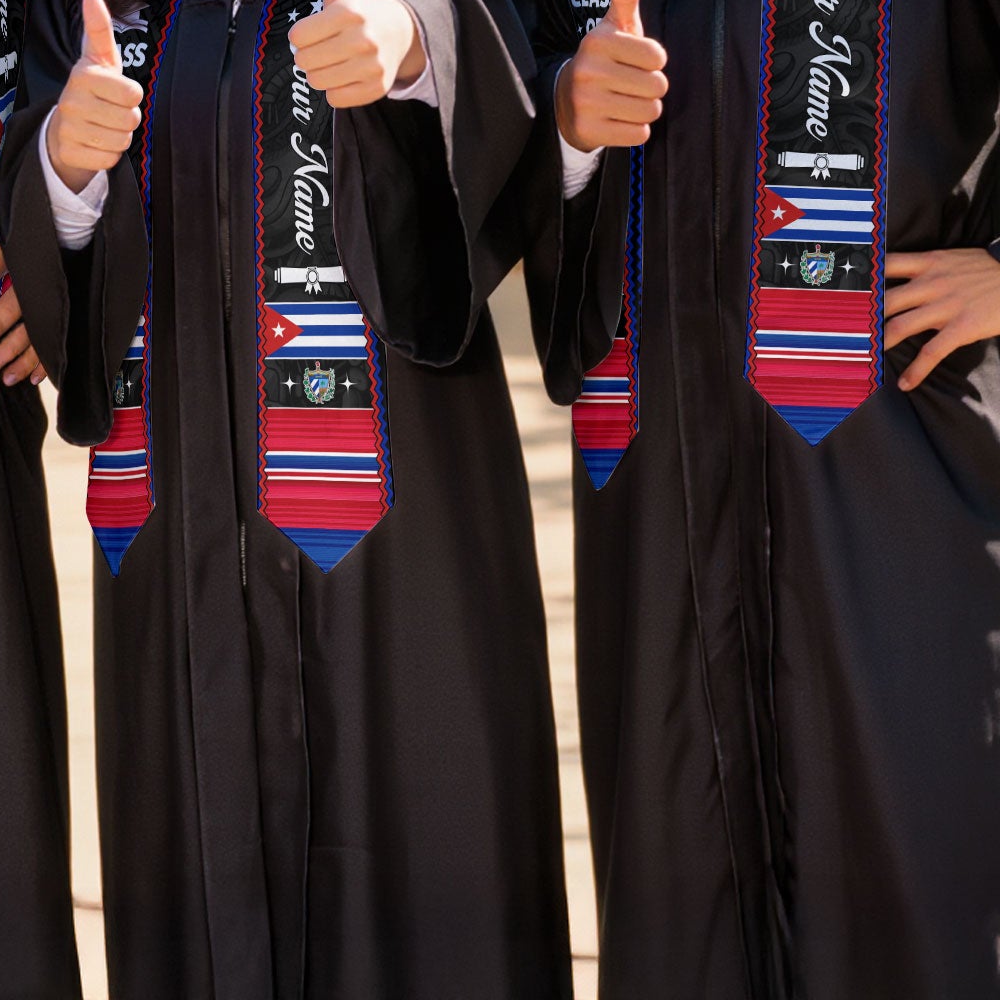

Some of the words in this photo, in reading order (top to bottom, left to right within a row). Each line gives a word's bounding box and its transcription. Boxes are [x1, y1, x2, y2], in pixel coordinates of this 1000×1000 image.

[290, 43, 314, 125] our
[805, 21, 852, 142] Name
[290, 131, 330, 256] Name
